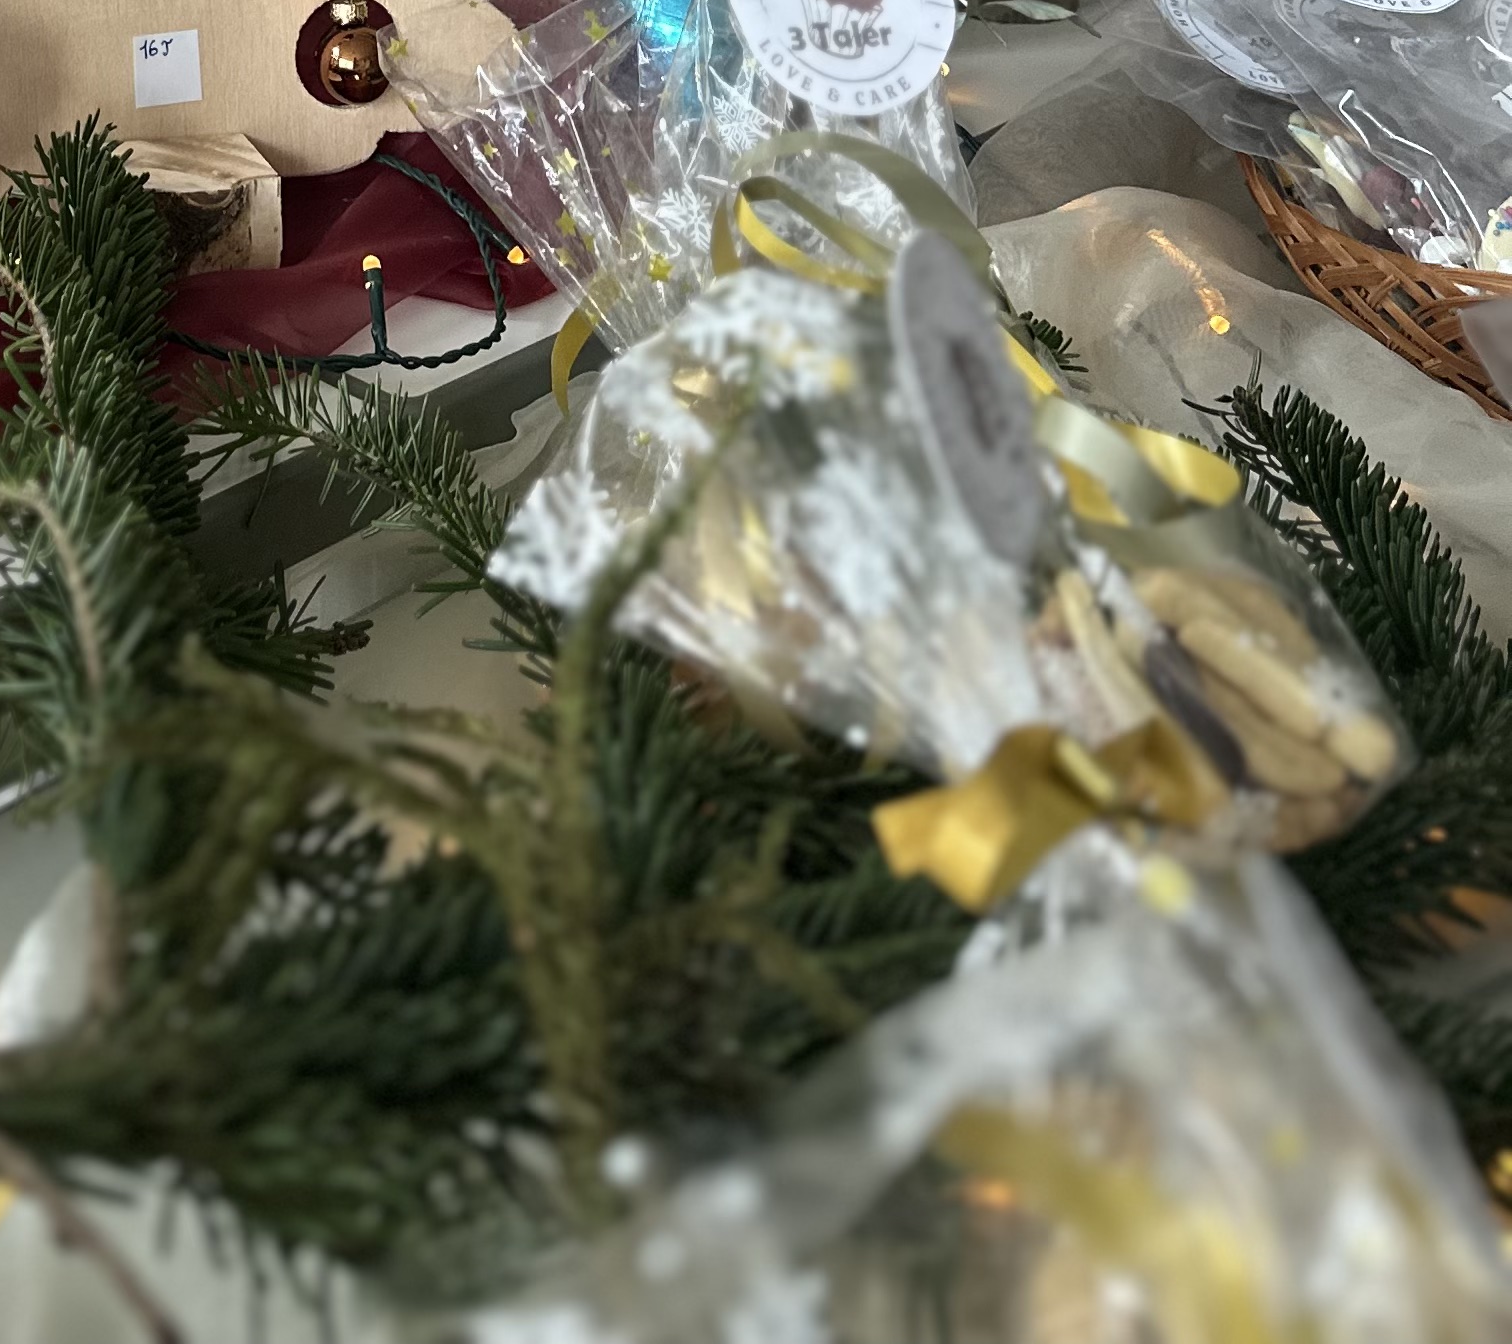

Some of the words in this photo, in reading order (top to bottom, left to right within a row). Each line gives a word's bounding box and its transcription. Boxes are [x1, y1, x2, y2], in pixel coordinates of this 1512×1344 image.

[788, 27, 806, 51] 3
[811, 21, 892, 50] Taler
[759, 38, 814, 91] LOVE
[828, 87, 840, 102] &
[855, 76, 912, 107] CARE
